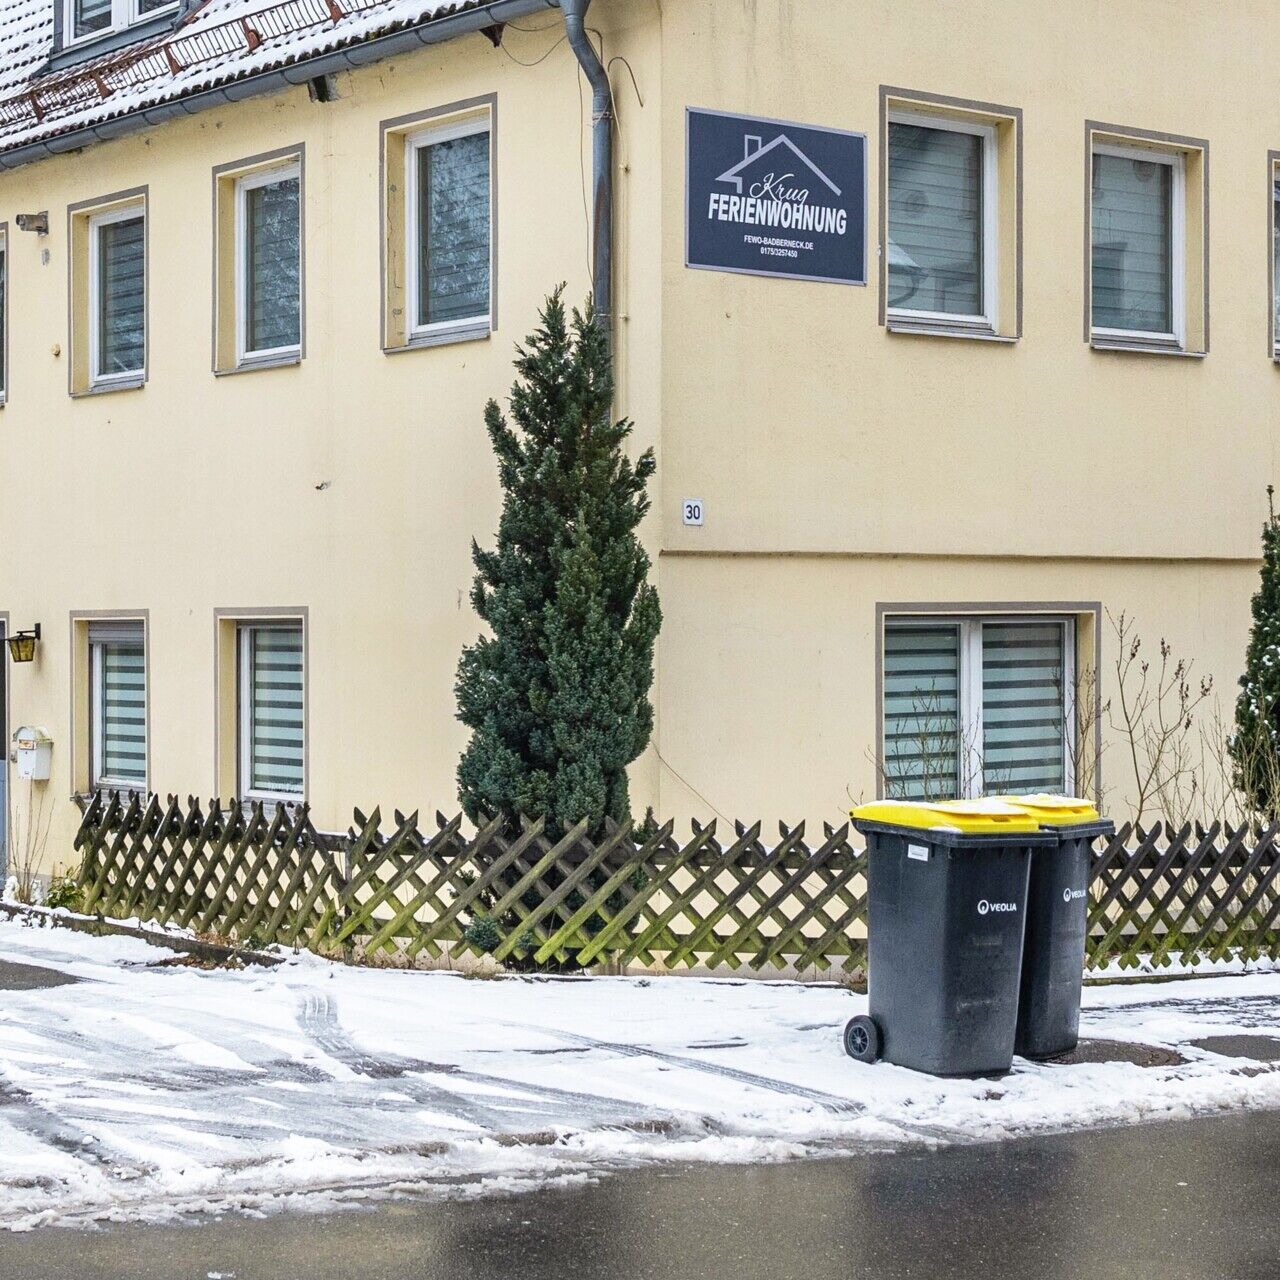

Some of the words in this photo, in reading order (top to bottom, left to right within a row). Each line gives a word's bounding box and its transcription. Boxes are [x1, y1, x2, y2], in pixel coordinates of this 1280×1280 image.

[750, 173, 809, 207] Krug
[708, 192, 847, 235] FERIENWOHNUNG
[744, 234, 814, 250] FEWO-BADBERNECK.DE
[685, 504, 701, 520] 30
[989, 902, 1017, 912] VEOLIA
